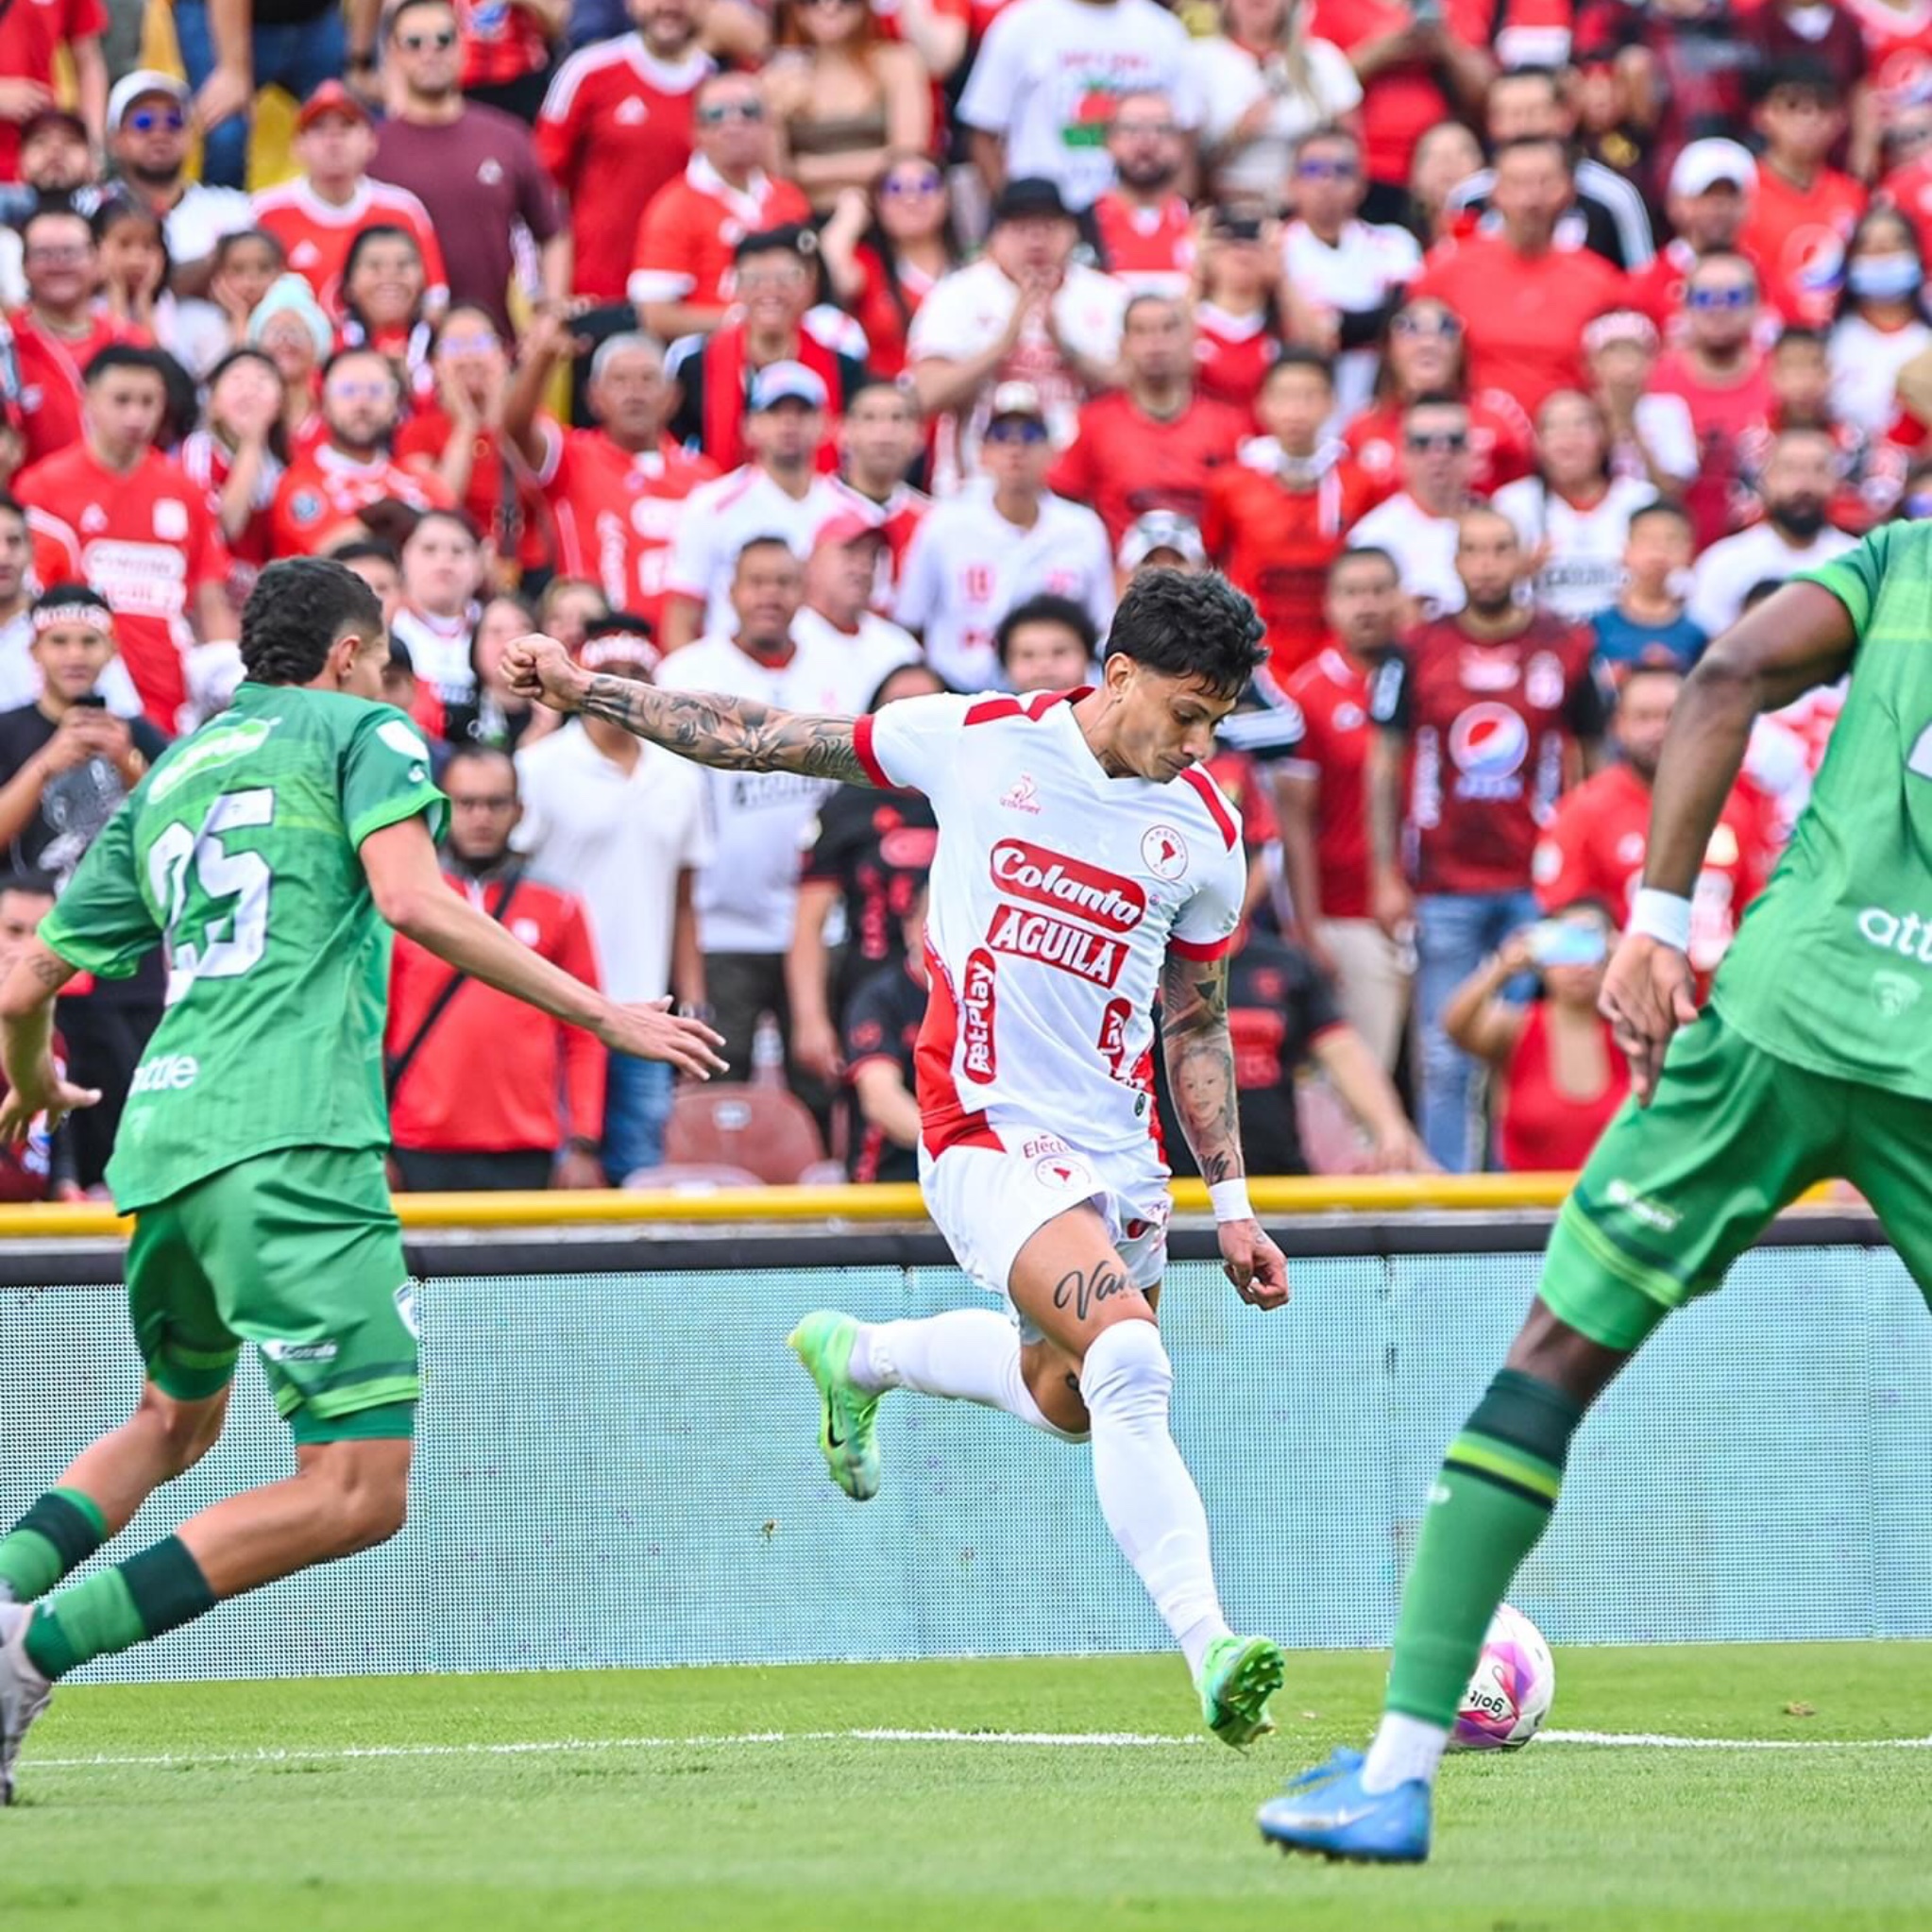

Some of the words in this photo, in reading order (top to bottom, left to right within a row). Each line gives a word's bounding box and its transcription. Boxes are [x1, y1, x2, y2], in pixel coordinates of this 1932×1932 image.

[148, 788, 274, 1007] 25
[992, 846, 1142, 925] Colanta
[993, 908, 1117, 984] AGUILA
